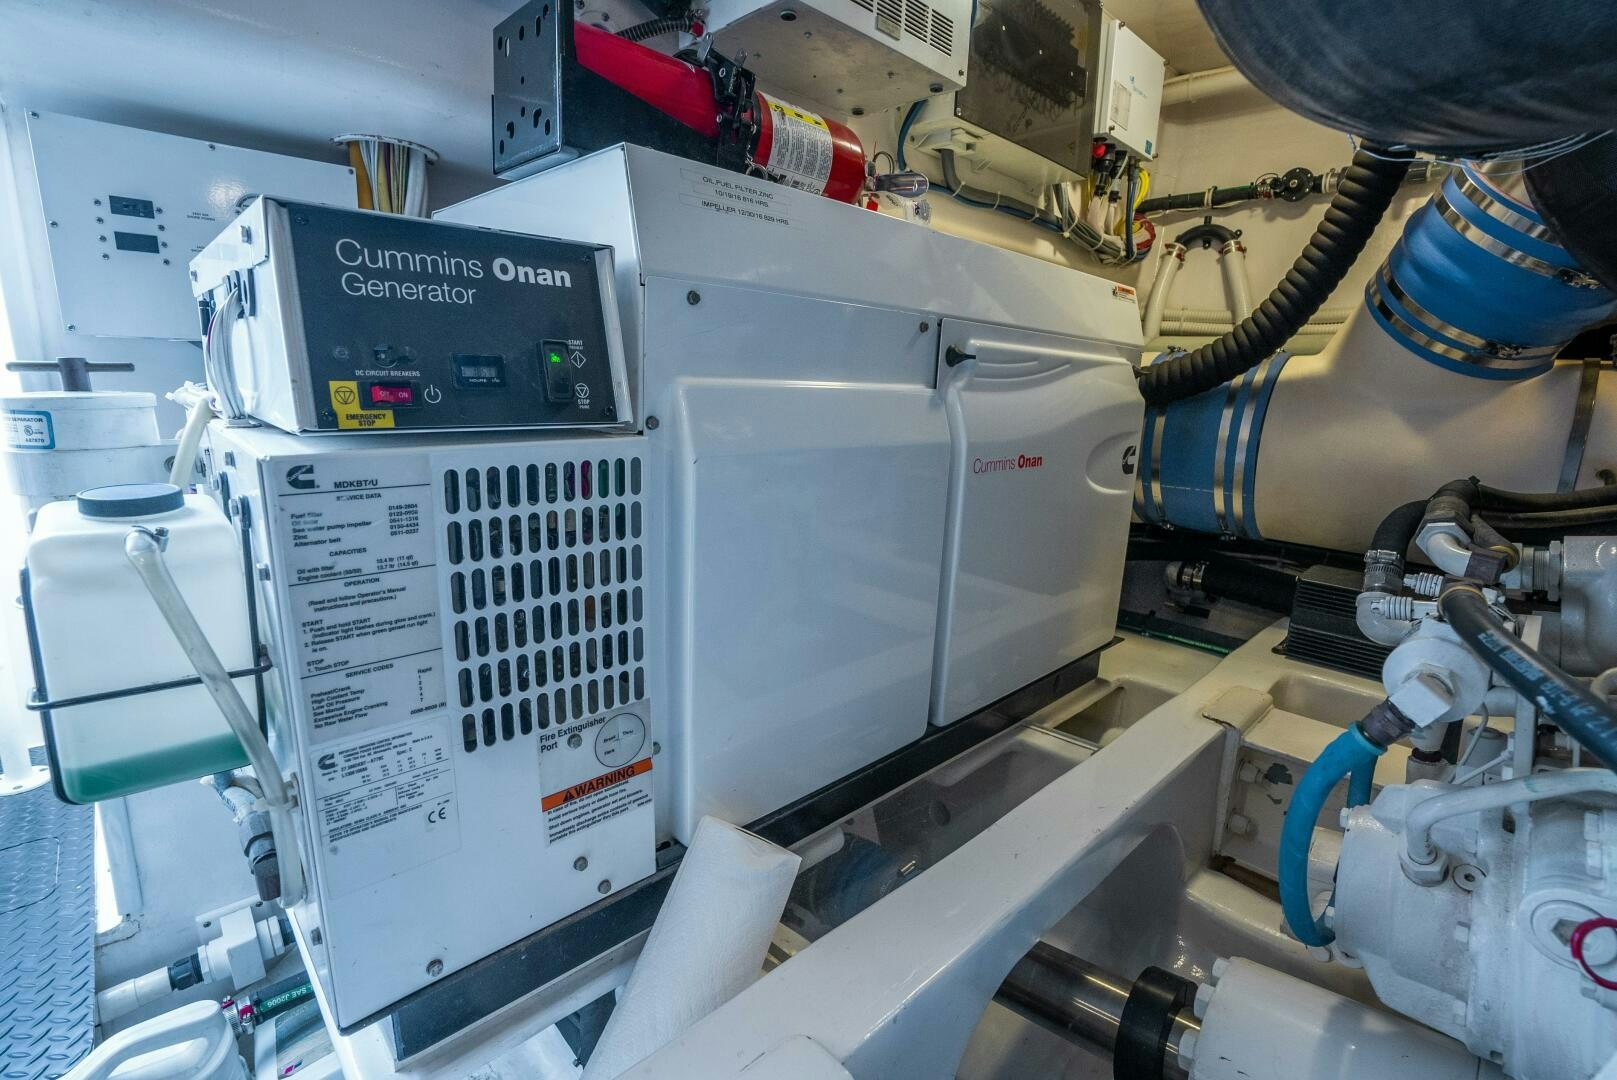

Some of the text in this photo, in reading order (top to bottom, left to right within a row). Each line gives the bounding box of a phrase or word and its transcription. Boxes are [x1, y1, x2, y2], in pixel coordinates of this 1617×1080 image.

[336, 238, 572, 288] Cummins Onan
[341, 271, 477, 304] Generator
[973, 454, 1043, 474] Cummins Onan
[327, 523, 346, 531] pump
[294, 539, 327, 547] Alternator
[329, 548, 367, 557] CAPACITIES
[344, 578, 380, 587] OPERATION
[302, 619, 323, 628] START
[310, 626, 325, 634] Push
[352, 617, 371, 626] START
[335, 634, 355, 642] START
[372, 627, 388, 635] green
[306, 659, 325, 667] STOP
[333, 660, 350, 668] STOP
[345, 663, 394, 679] SERVICE CODES
[325, 705, 346, 714] Manual
[324, 719, 337, 727] Raw
[337, 716, 354, 724] Water
[355, 712, 368, 720] Flow
[540, 733, 556, 744] Fire
[558, 716, 606, 737] Extinguisher
[541, 742, 558, 753] Port
[576, 766, 635, 796] WARNING
[428, 807, 446, 823] CE
[267, 987, 306, 1007] SAE J2006
